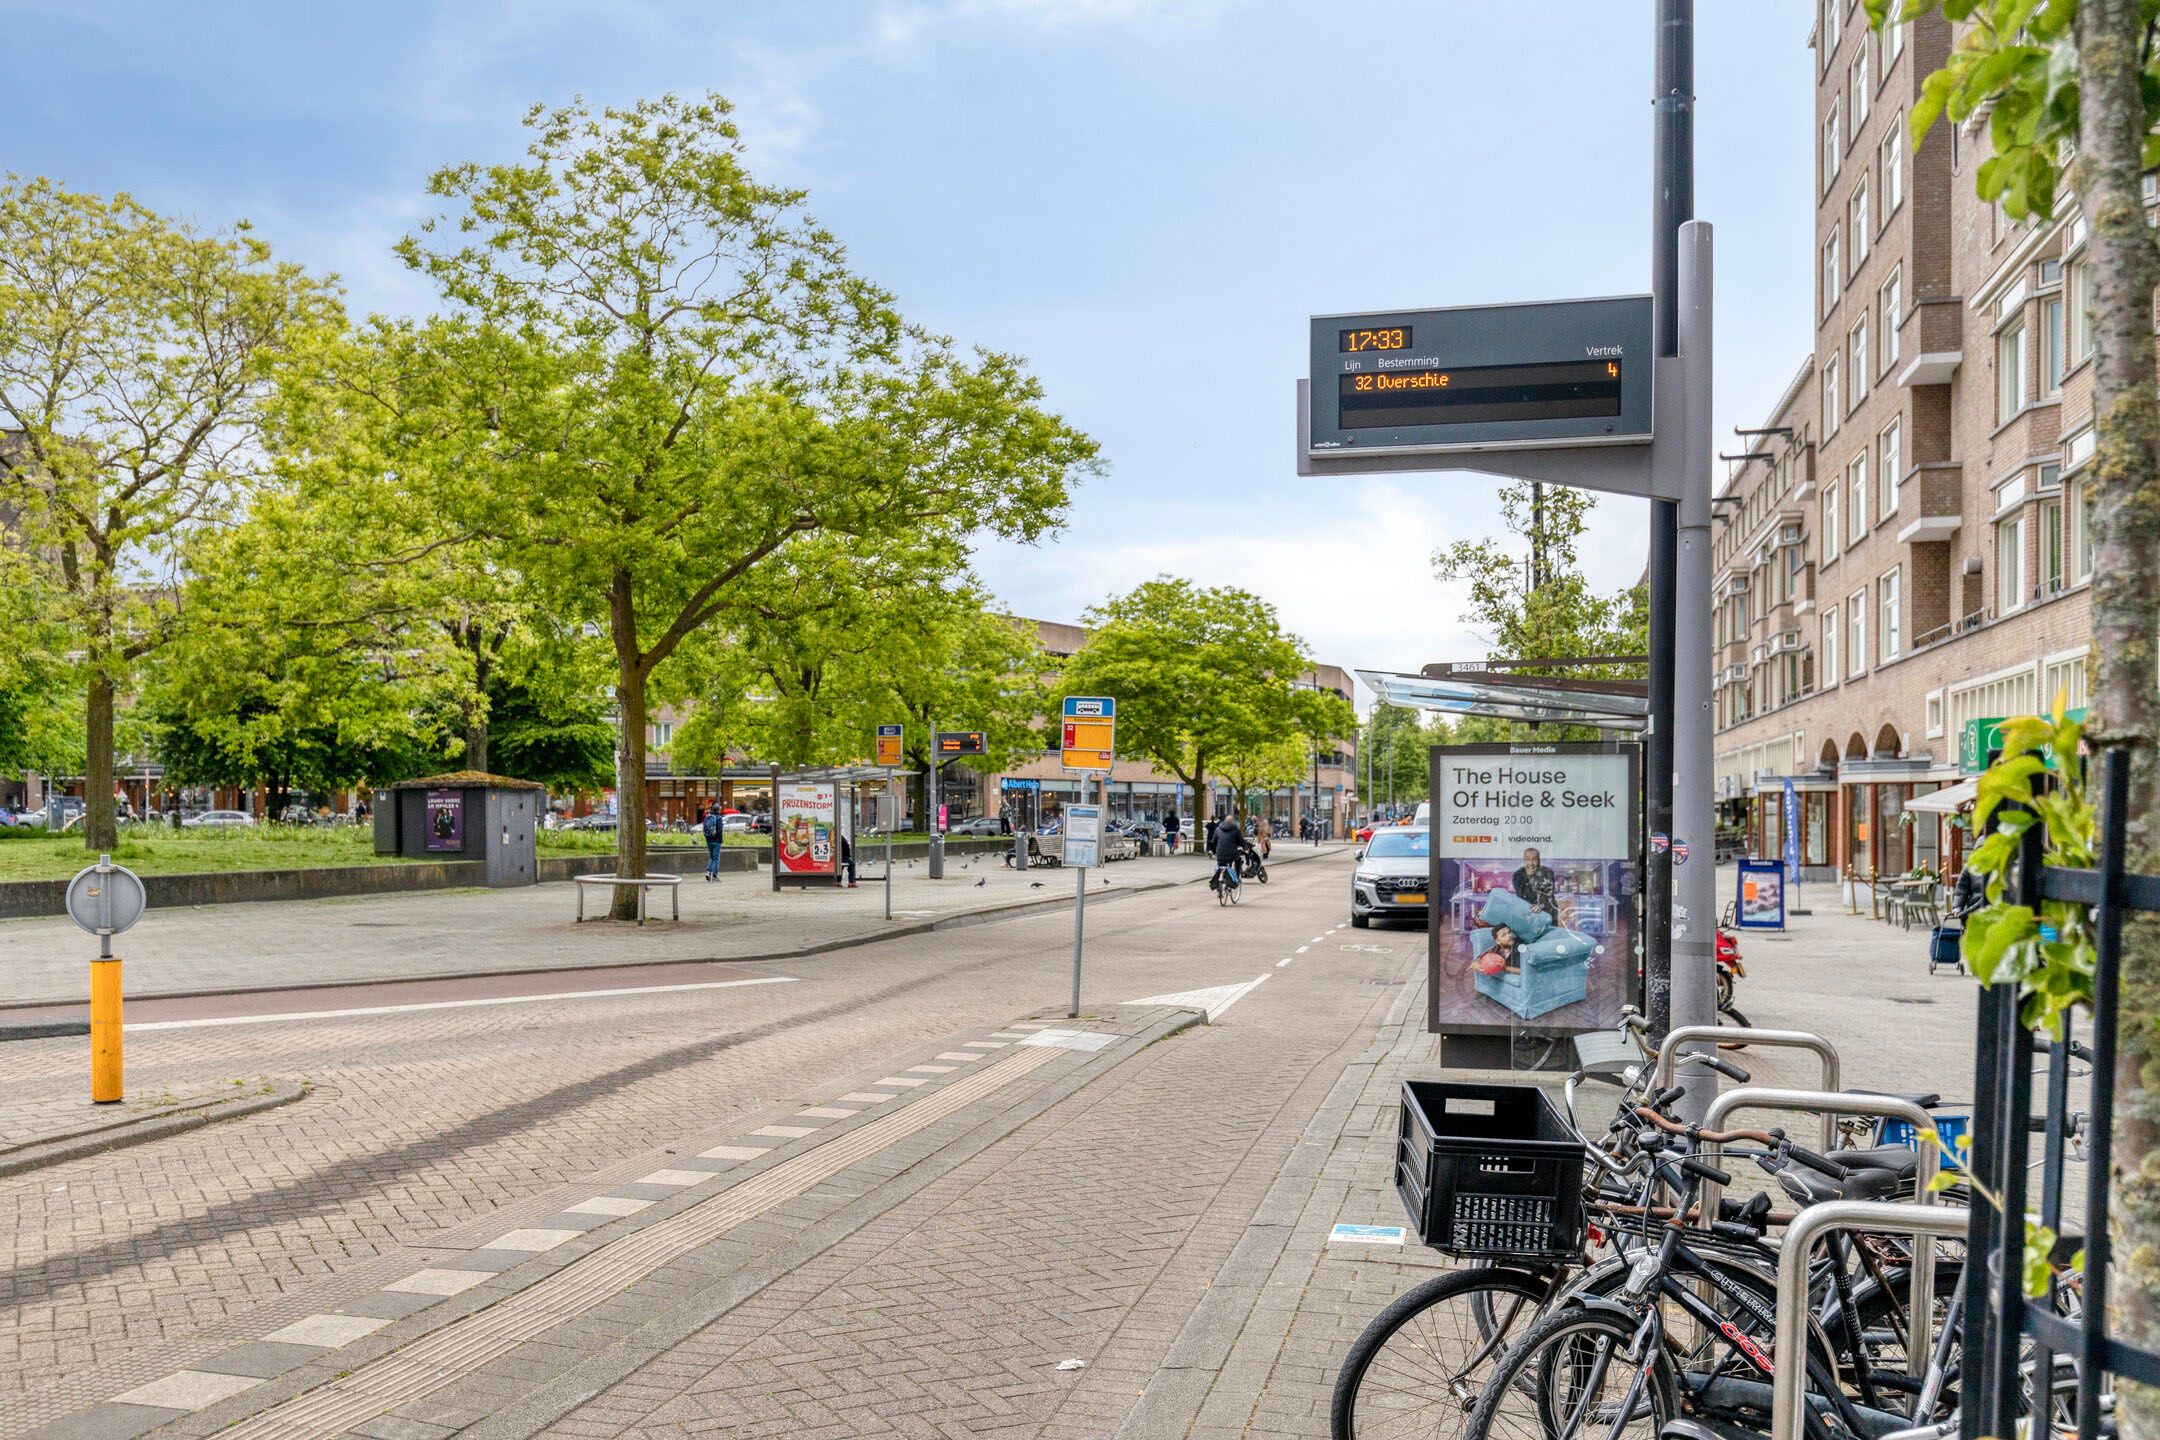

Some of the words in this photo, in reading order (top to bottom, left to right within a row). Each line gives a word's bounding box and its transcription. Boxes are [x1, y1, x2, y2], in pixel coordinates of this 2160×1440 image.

[1348, 330, 1403, 352] 17:33
[1345, 360, 1361, 372] Lijn
[1378, 355, 1439, 369] Bestemming
[1586, 344, 1623, 357] Vertrek
[1355, 375, 1372, 390] 32
[1377, 373, 1449, 390] Overschie
[1608, 362, 1618, 377] 4
[1457, 663, 1480, 671] 3461
[1510, 746, 1531, 754] Bauer
[1453, 767, 1492, 785] The
[1498, 768, 1566, 785] House
[1453, 790, 1479, 808] Of
[1485, 790, 1533, 808] Hide
[1540, 790, 1555, 808] &
[1562, 790, 1616, 808] Seek
[1453, 815, 1500, 826] Zaterdag
[1504, 815, 1533, 825] 20.00
